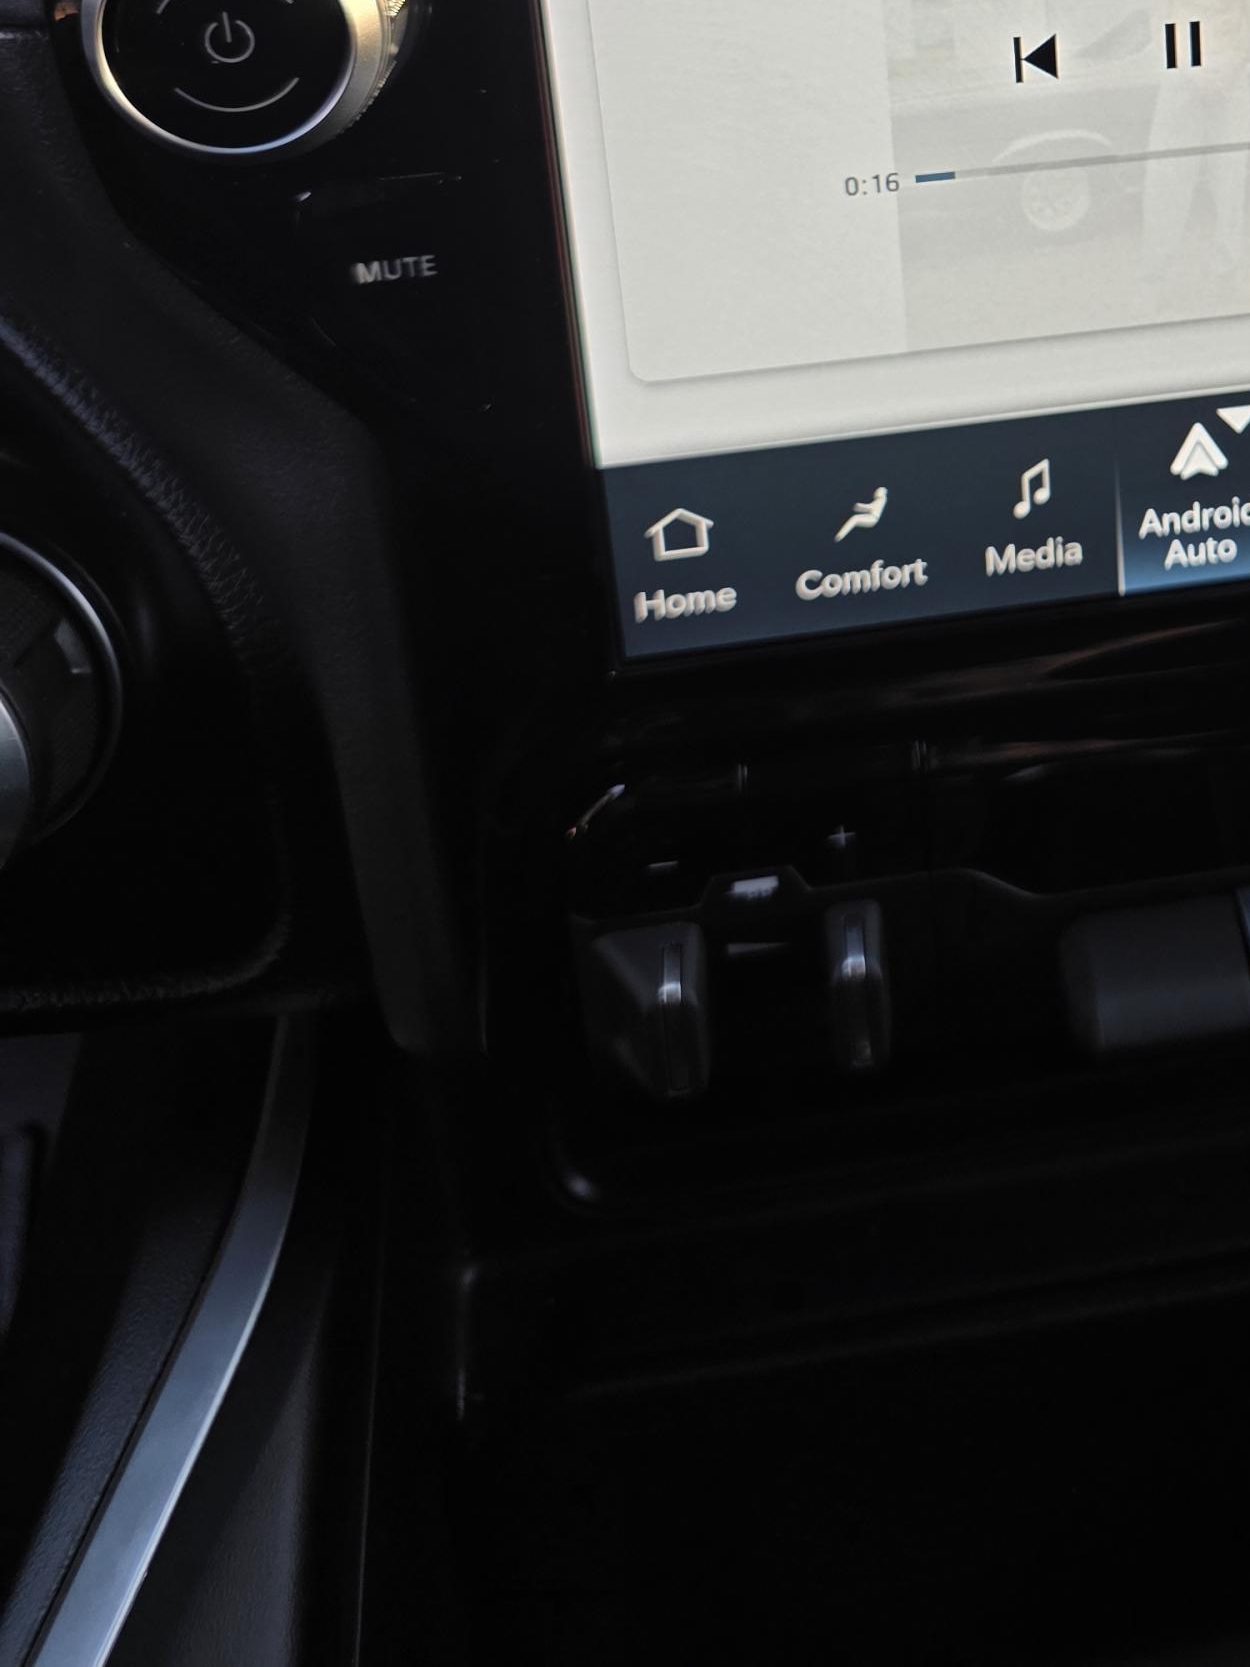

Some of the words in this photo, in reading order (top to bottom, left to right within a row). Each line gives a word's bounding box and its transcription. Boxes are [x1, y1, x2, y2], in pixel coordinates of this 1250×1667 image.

[844, 172, 900, 197] 0:16
[351, 254, 438, 285] MUTE
[984, 537, 1083, 577] Media
[1163, 536, 1238, 571] Auto
[795, 559, 928, 600] Comfort
[633, 585, 738, 624] Home
